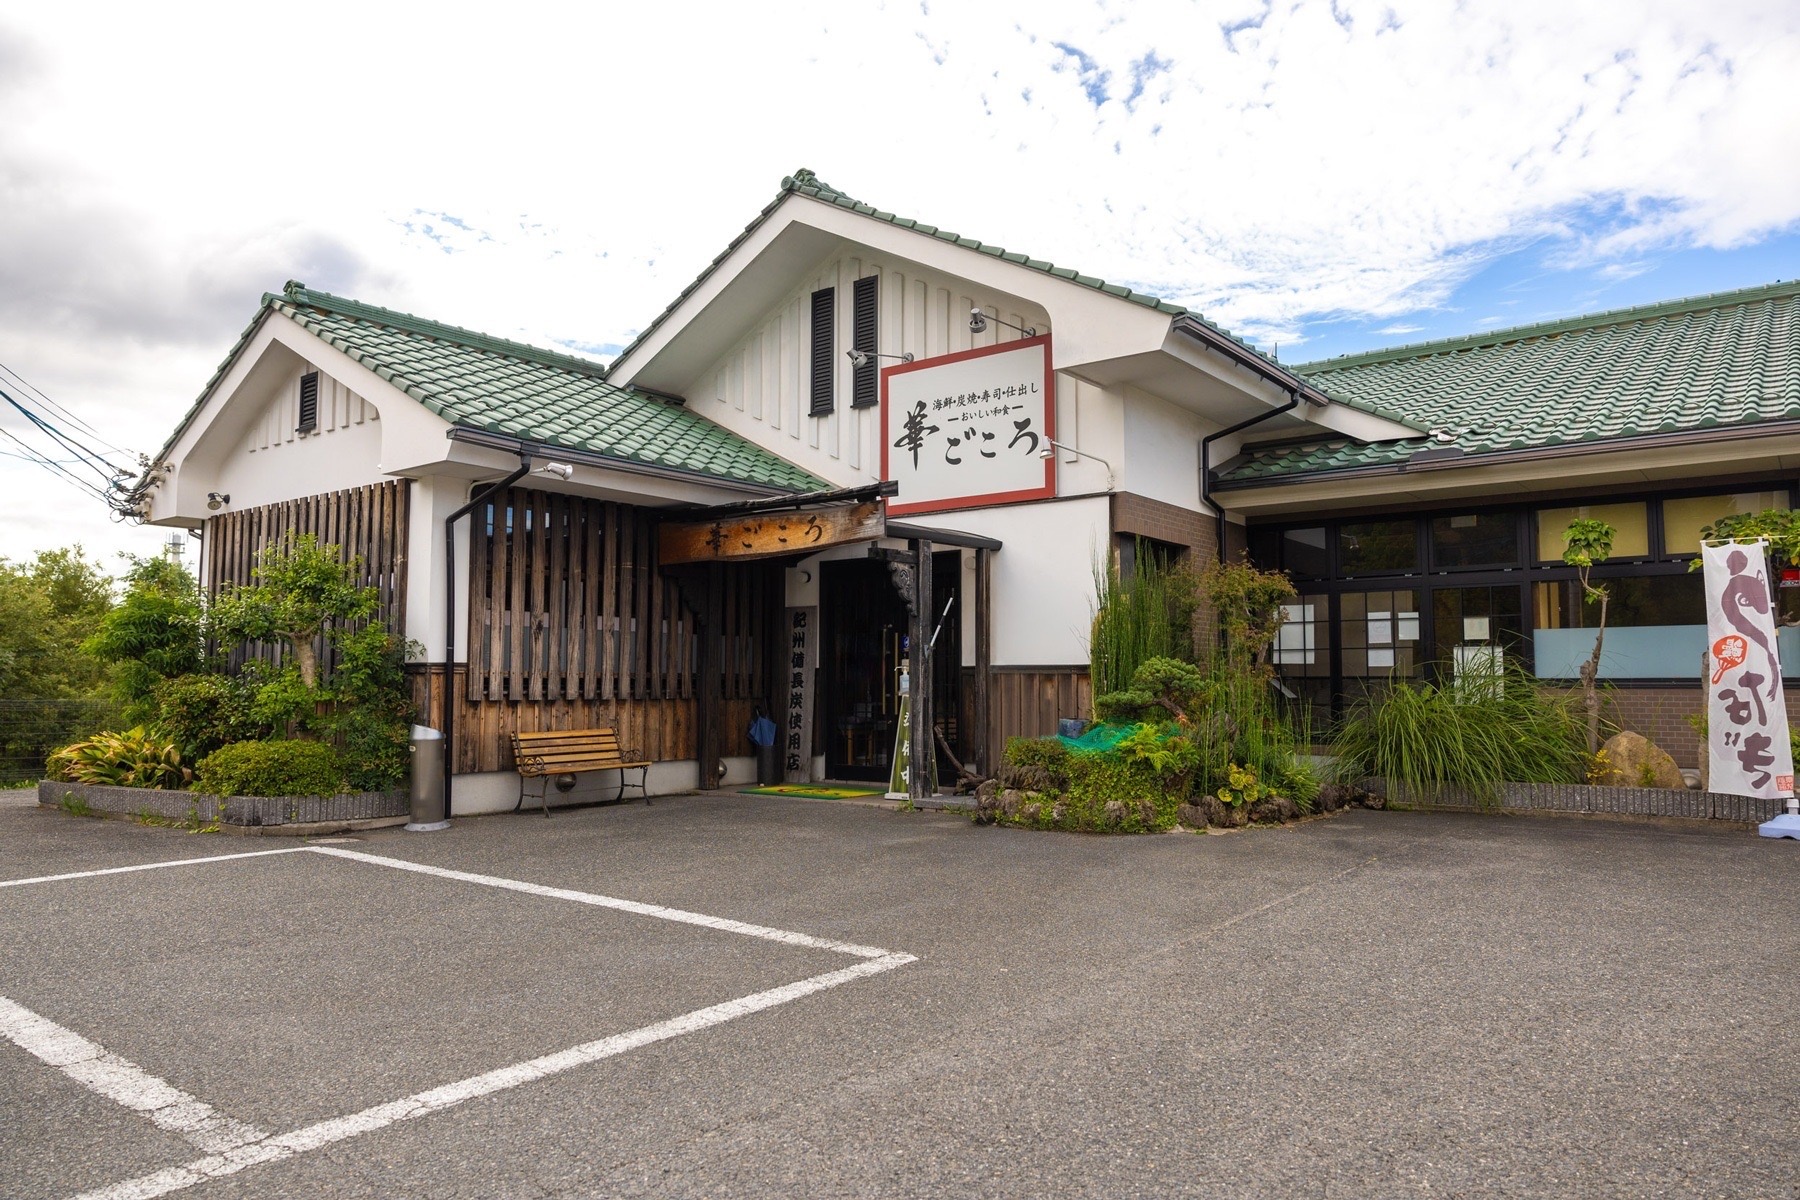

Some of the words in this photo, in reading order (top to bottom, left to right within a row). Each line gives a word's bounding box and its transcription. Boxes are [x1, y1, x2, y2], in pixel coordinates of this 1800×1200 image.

[893, 400, 1039, 471] 華ごころ
[705, 515, 823, 557] 華ごころ
[786, 611, 807, 771] 紀州備長炭使用店
